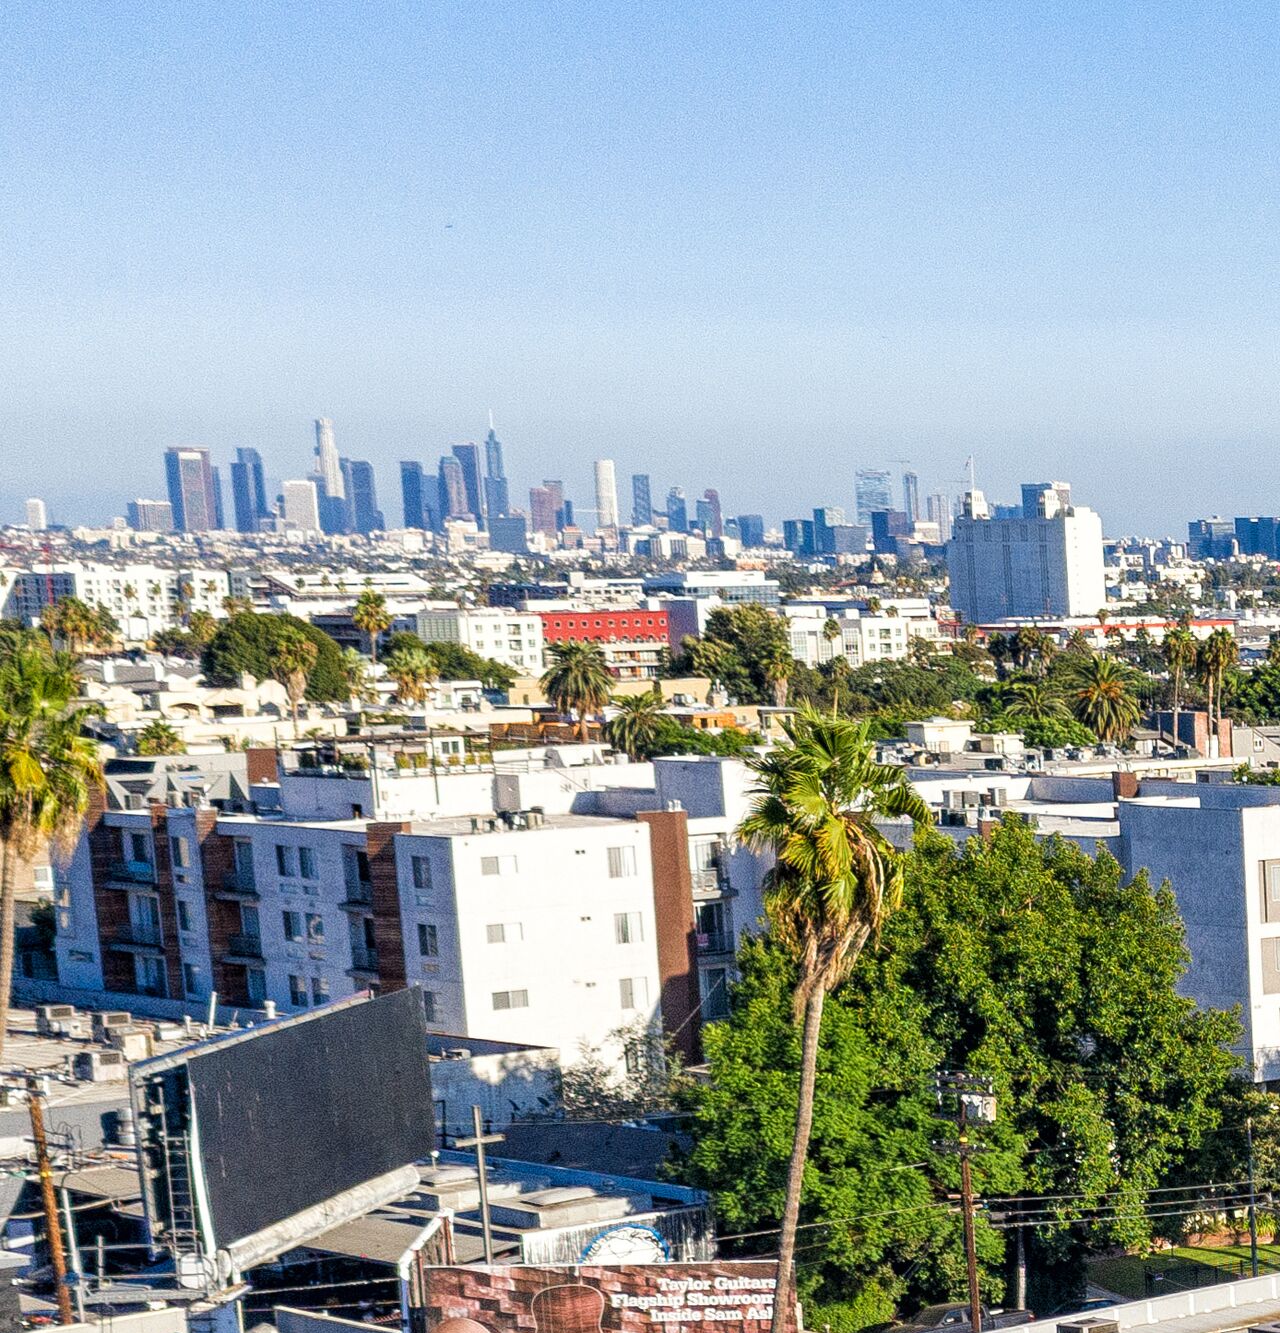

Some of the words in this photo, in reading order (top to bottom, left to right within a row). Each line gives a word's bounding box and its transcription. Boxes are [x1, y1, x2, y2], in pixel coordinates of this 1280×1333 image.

[657, 1277, 711, 1294] Taylor
[714, 1276, 777, 1290] Guitars
[610, 1294, 684, 1309] Flagship
[650, 1309, 700, 1322] Inside
[704, 1308, 742, 1321] Sam
